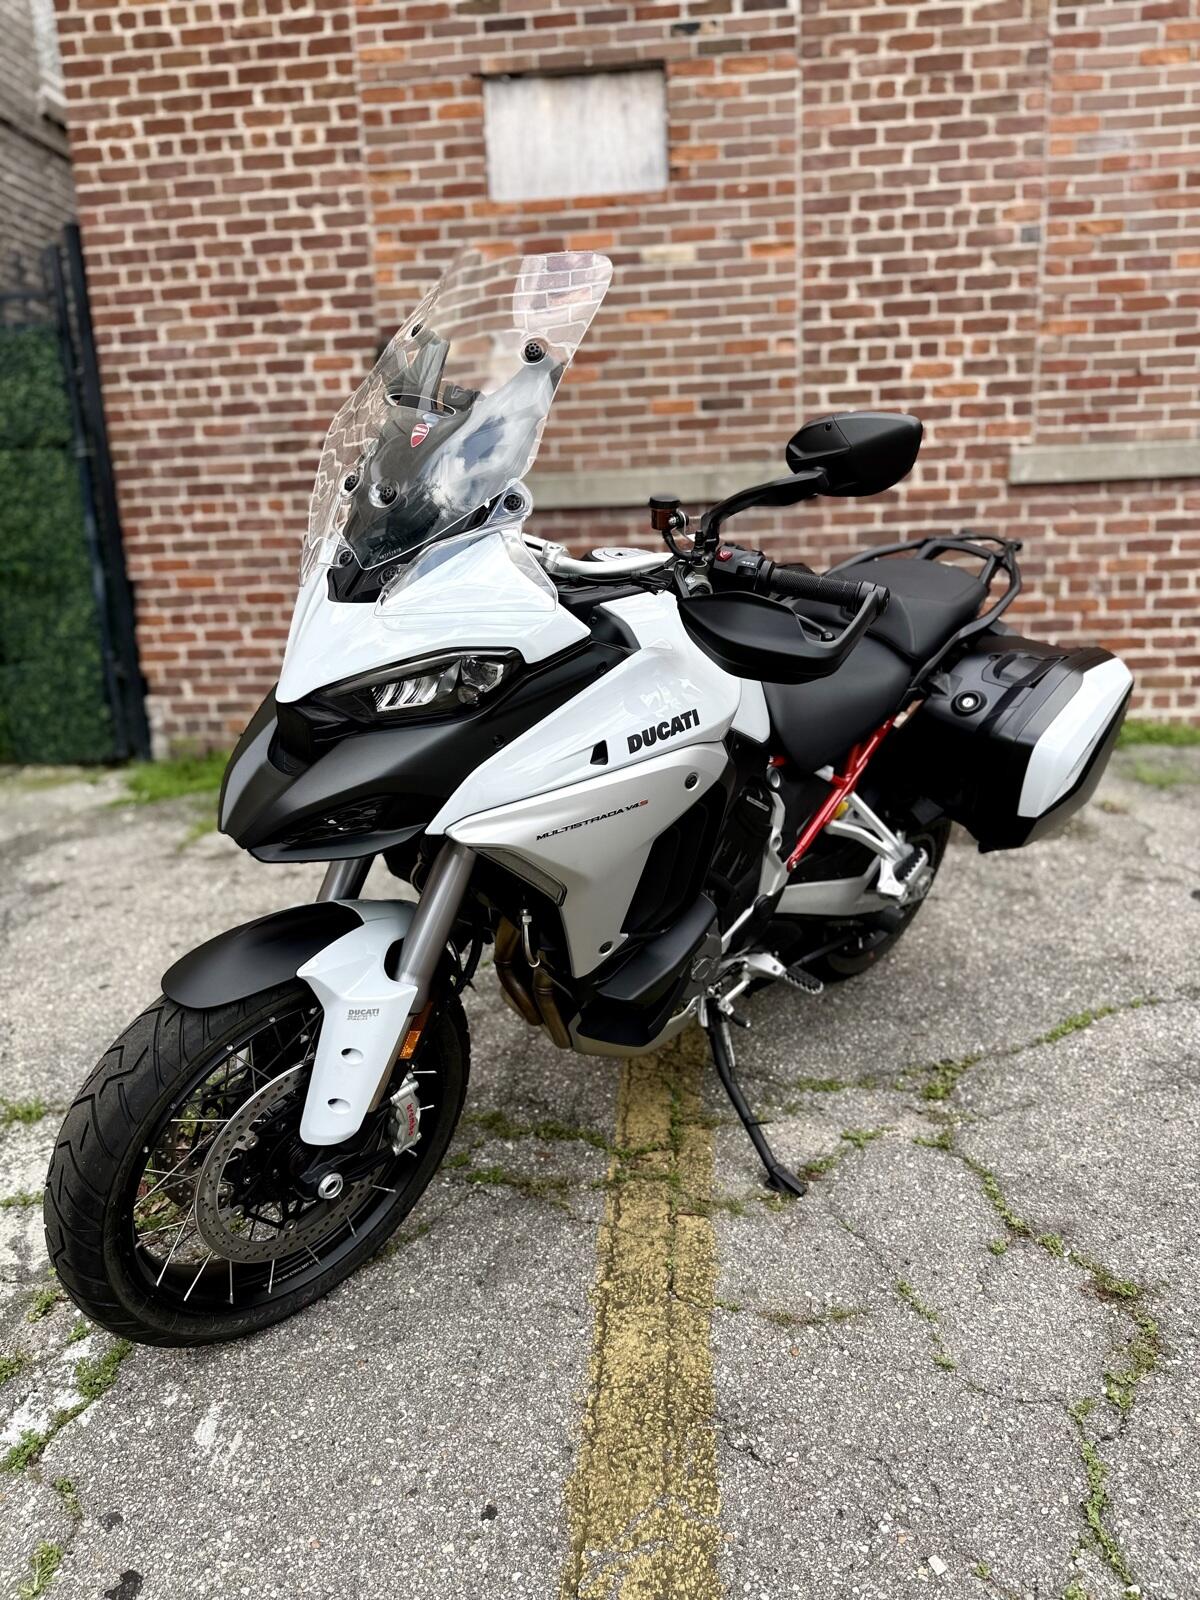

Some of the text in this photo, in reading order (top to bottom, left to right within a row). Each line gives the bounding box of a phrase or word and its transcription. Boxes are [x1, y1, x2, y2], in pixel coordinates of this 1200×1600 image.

[627, 709, 700, 754] DUCATI
[536, 808, 624, 841] MULTISTRADA
[348, 1008, 380, 1016] DUCATI
[406, 1102, 416, 1137] brembo
